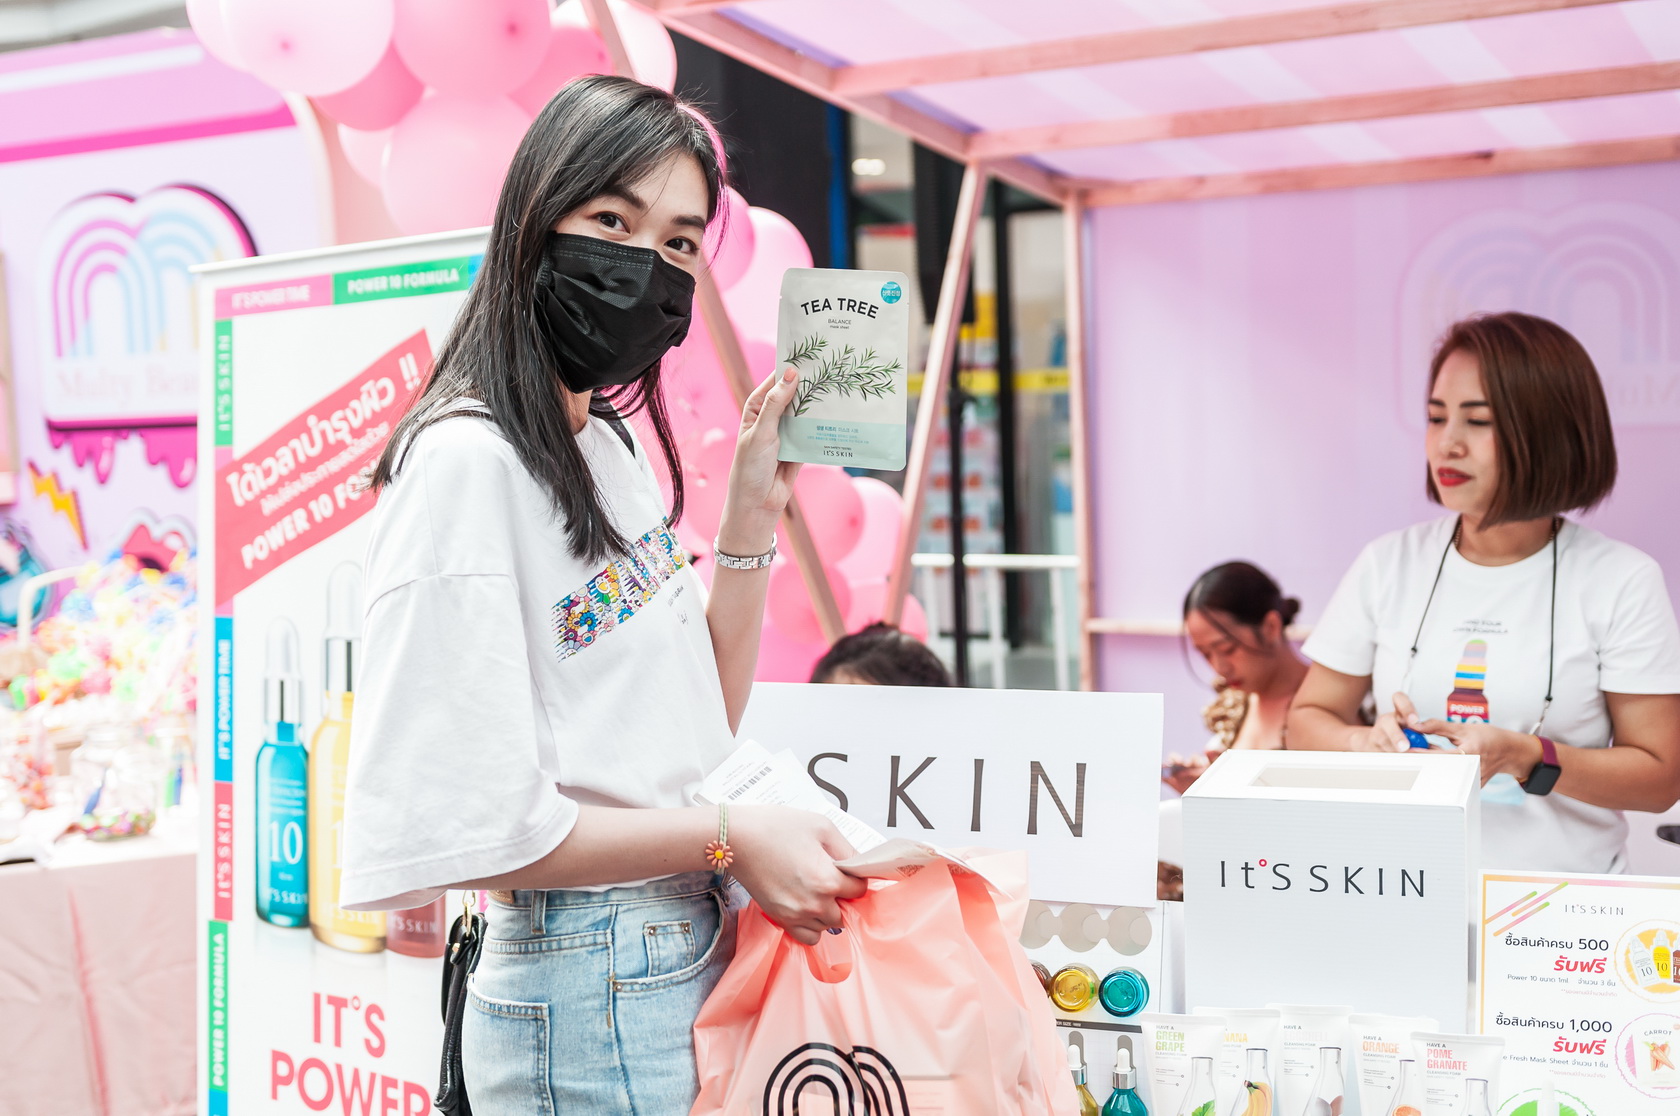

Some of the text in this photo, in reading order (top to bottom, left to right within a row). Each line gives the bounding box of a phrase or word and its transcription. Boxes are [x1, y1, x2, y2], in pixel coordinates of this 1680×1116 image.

[347, 268, 460, 294] POWER 10 FORMULA
[801, 297, 879, 319] TEA TREE
[218, 335, 231, 390] SKIN
[241, 507, 311, 569] POWER
[309, 494, 334, 523] 10
[218, 639, 231, 675] TIME
[218, 676, 231, 732] POWER
[1450, 704, 1485, 715] POWER
[807, 752, 1087, 838] SKIN
[217, 804, 232, 861] SKIN
[269, 820, 304, 865] 10
[1309, 864, 1424, 898] SKIN
[1591, 905, 1624, 916] SKIN
[1505, 932, 1609, 951] ซื้อสินค้าครบ 500
[213, 933, 224, 1008] FORMULA
[1553, 955, 1608, 974] รับฟรี
[1641, 966, 1653, 977] 10
[1656, 962, 1668, 972] 10
[1507, 973, 1527, 981] Power
[1496, 1012, 1613, 1033] ซื้อสินค้าครบ 1,000
[1156, 1030, 1185, 1042] GREEN
[1223, 1032, 1248, 1043] NANA
[1553, 1036, 1607, 1056] รับฟรี
[1155, 1041, 1185, 1052] GRAPE
[1362, 1041, 1400, 1054] ORANGE
[1427, 1048, 1453, 1060] POME
[213, 1028, 224, 1086] POWER
[1427, 1058, 1467, 1071] GRANATE
[1509, 1054, 1528, 1062] Fresh
[1549, 1057, 1569, 1065] Sheet
[271, 1049, 431, 1116] POWER
